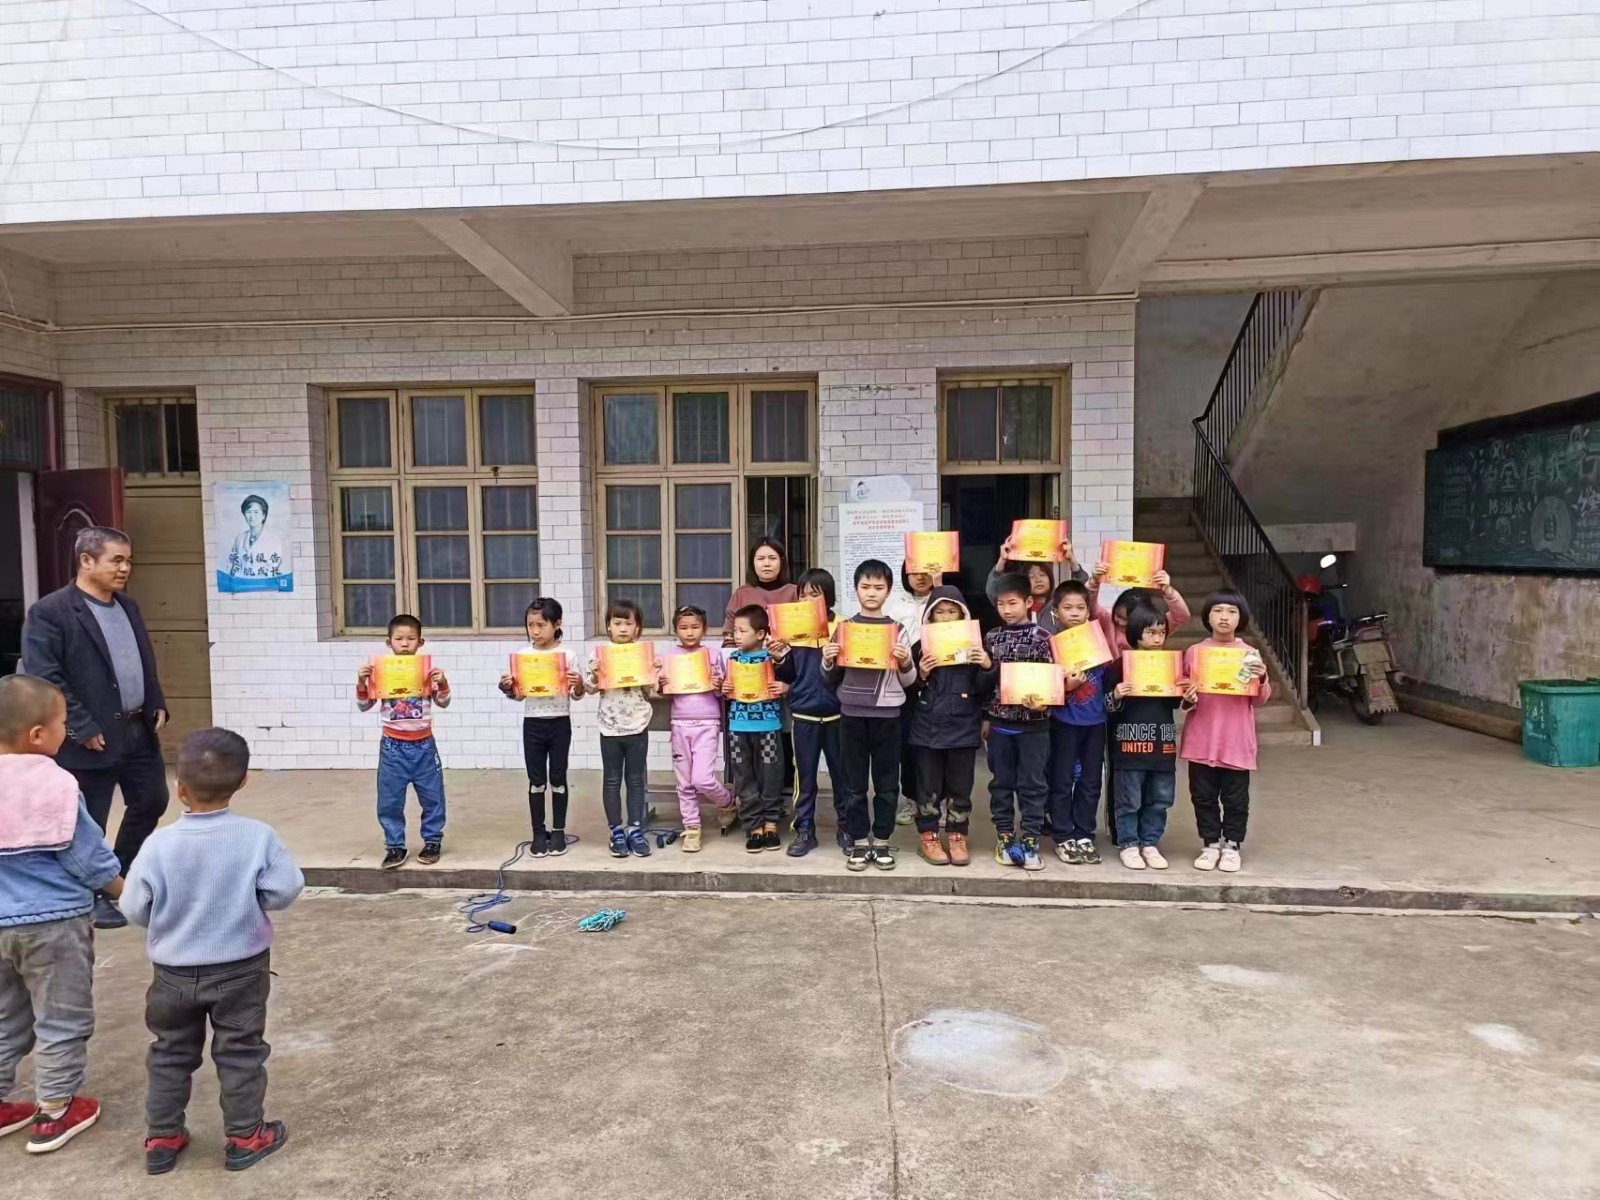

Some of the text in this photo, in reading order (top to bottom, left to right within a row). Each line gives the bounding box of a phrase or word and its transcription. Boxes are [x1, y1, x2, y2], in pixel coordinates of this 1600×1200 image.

[228, 552, 282, 564] 强制报告
[1117, 723, 1156, 741] SINCE
[1122, 742, 1154, 753] UNITED
